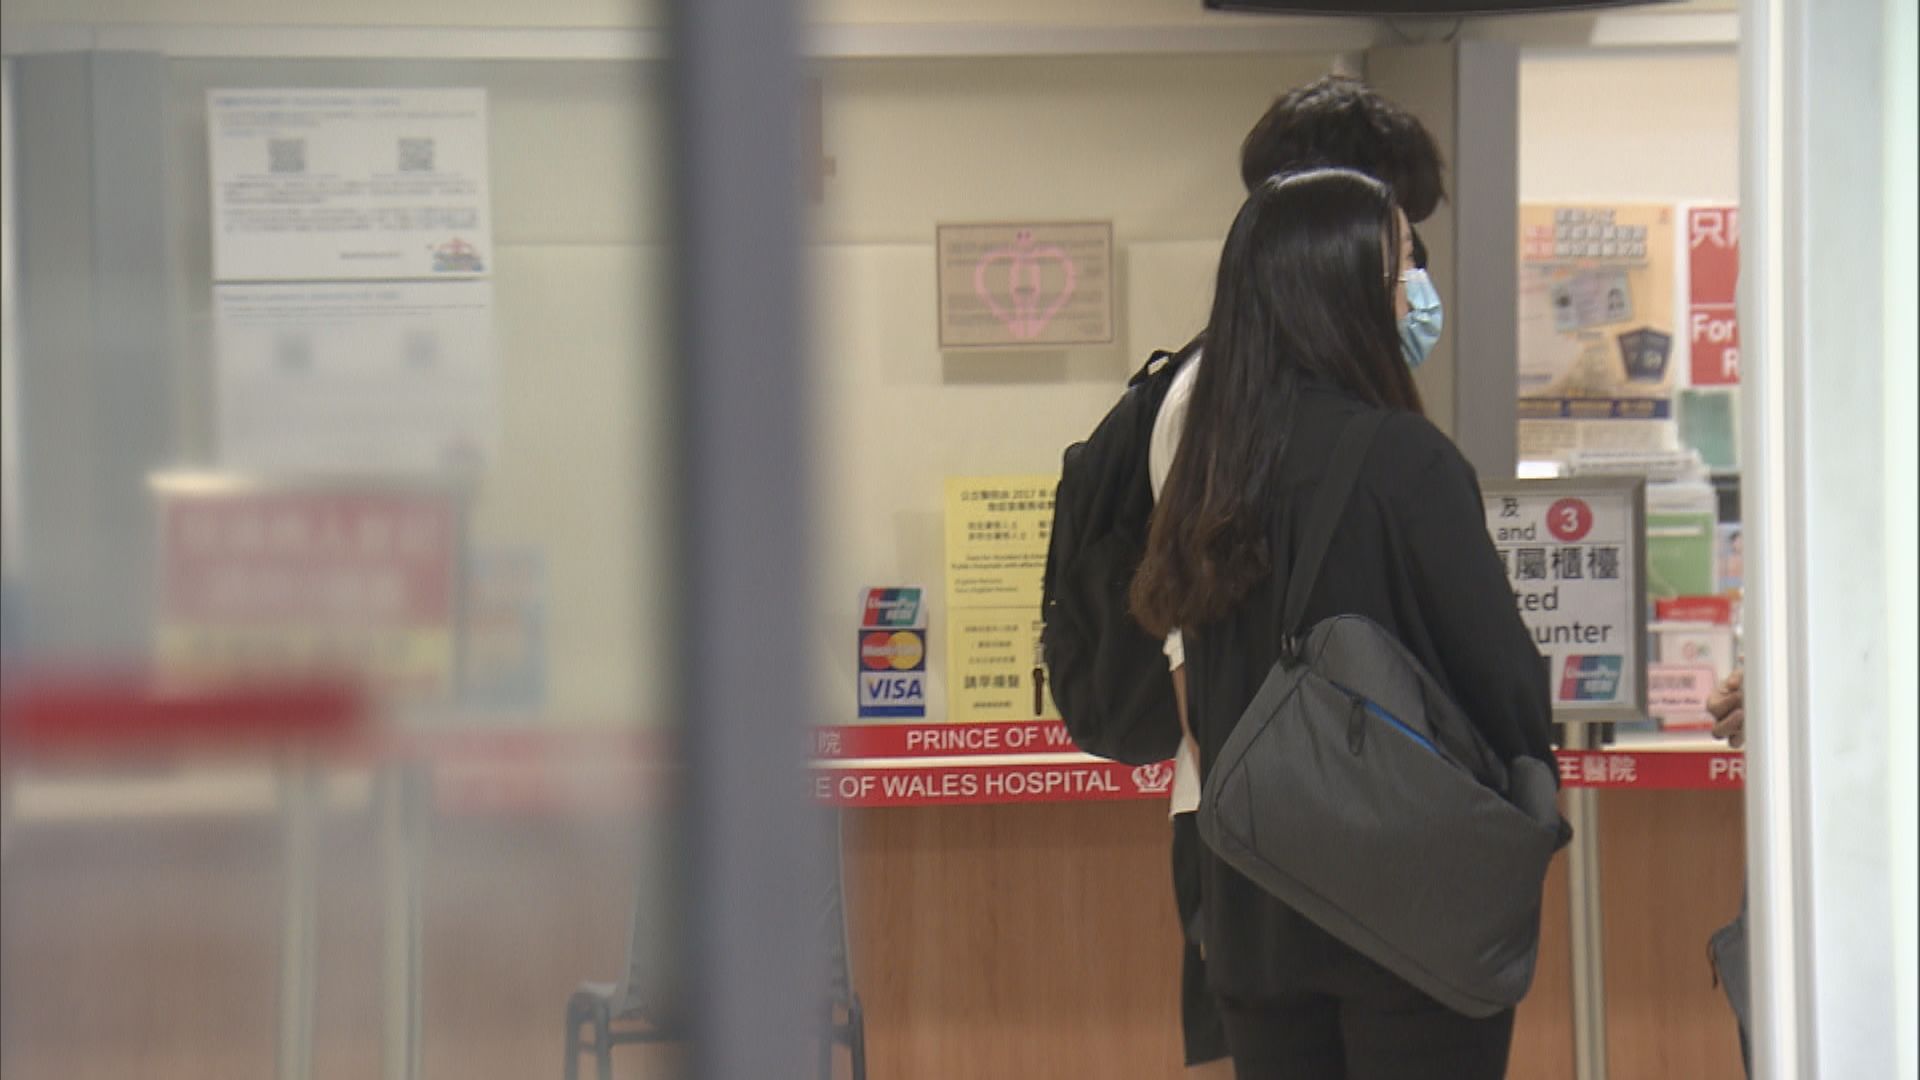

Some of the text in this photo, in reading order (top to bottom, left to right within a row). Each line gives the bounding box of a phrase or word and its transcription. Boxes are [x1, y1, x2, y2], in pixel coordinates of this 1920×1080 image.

[1692, 313, 1735, 342] For
[1499, 498, 1520, 518] 及
[1497, 522, 1536, 540] and
[1560, 507, 1578, 533] 3
[1528, 623, 1611, 644] unter
[867, 678, 922, 699] VISA
[907, 728, 998, 752] PRINCE
[1005, 726, 1038, 746] OF
[839, 776, 877, 798] OF
[882, 773, 978, 797] WALES
[985, 770, 1120, 795] HOSPITAL
